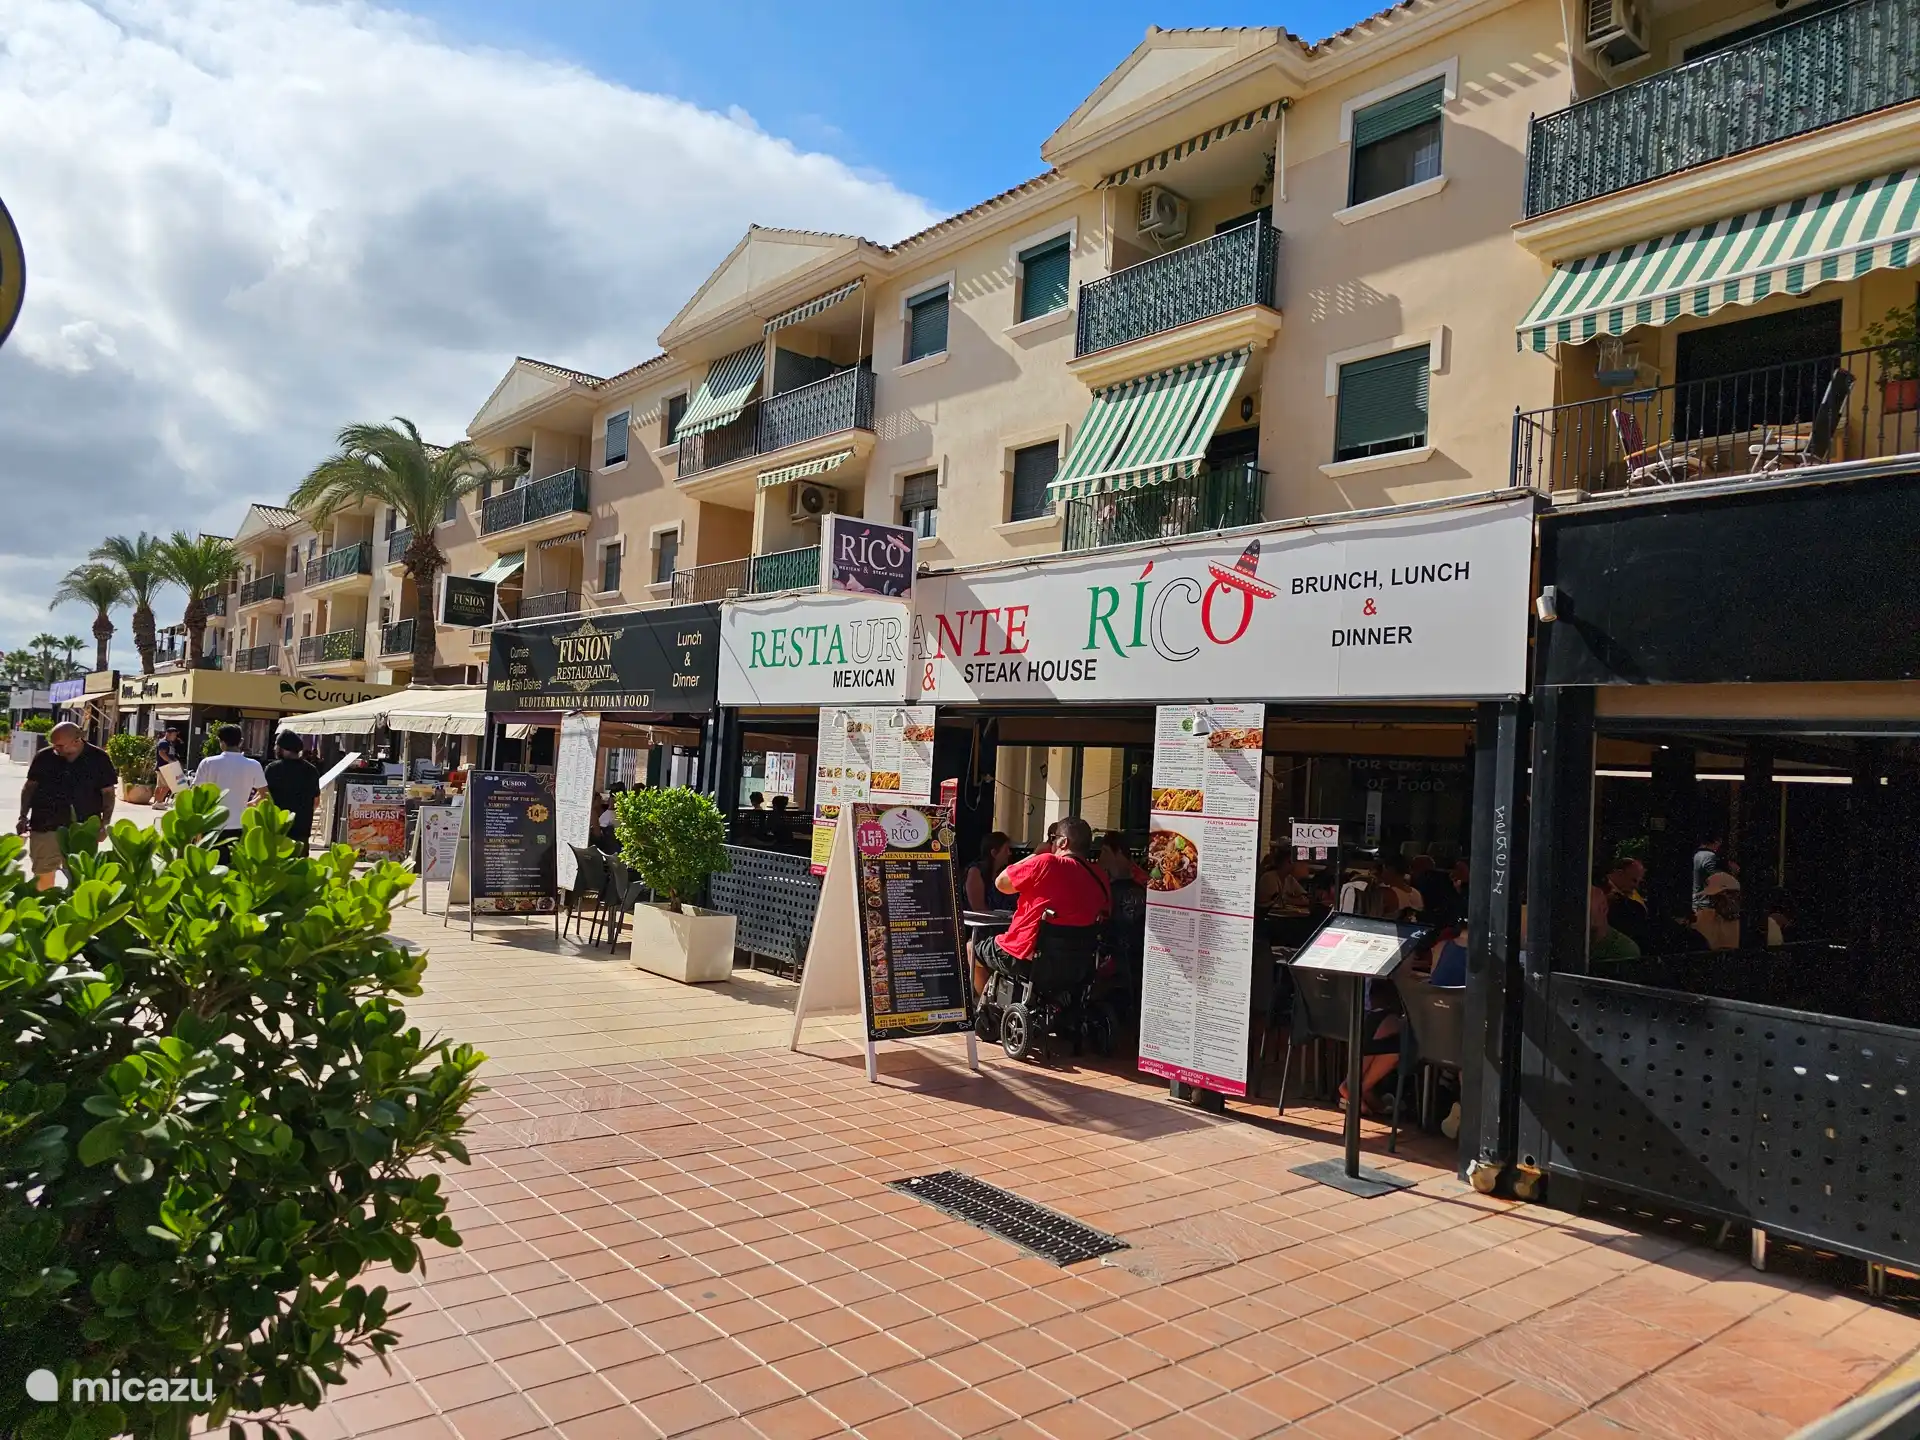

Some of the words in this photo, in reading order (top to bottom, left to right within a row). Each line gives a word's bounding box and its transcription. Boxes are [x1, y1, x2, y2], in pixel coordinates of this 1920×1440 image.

[840, 529, 905, 570] RÍCO
[863, 566, 869, 574] &
[454, 593, 485, 607] FUSION
[1362, 598, 1378, 616] &
[452, 604, 485, 614] RESTAURANT
[1082, 560, 1255, 662] RÍCO
[1291, 570, 1383, 595] BRUNCH,
[1390, 561, 1471, 587] LUNCH
[677, 630, 702, 647] Lunch
[1331, 625, 1413, 648] DINNER
[510, 646, 530, 659] Curries
[558, 635, 613, 663] FUSION
[684, 652, 691, 667] &
[509, 663, 528, 676] Fajitas
[556, 664, 612, 681] RESTAURANT
[833, 669, 895, 689] MEXICAN
[921, 662, 936, 692] &
[963, 661, 1022, 684] STEAK
[1027, 659, 1097, 683] HOUSE
[493, 679, 506, 692] Meat
[506, 680, 511, 691] &
[511, 678, 523, 691] Fish
[523, 679, 542, 691] Dishes
[672, 672, 700, 688] Dinner
[519, 695, 581, 708] MEDITERRANEAN
[582, 695, 589, 707] &
[590, 694, 622, 708] INDIAN
[623, 694, 650, 707] FOOD
[354, 810, 401, 820] BREAKFAST
[891, 826, 919, 841] RÍCO
[1296, 825, 1333, 839] RÍCO
